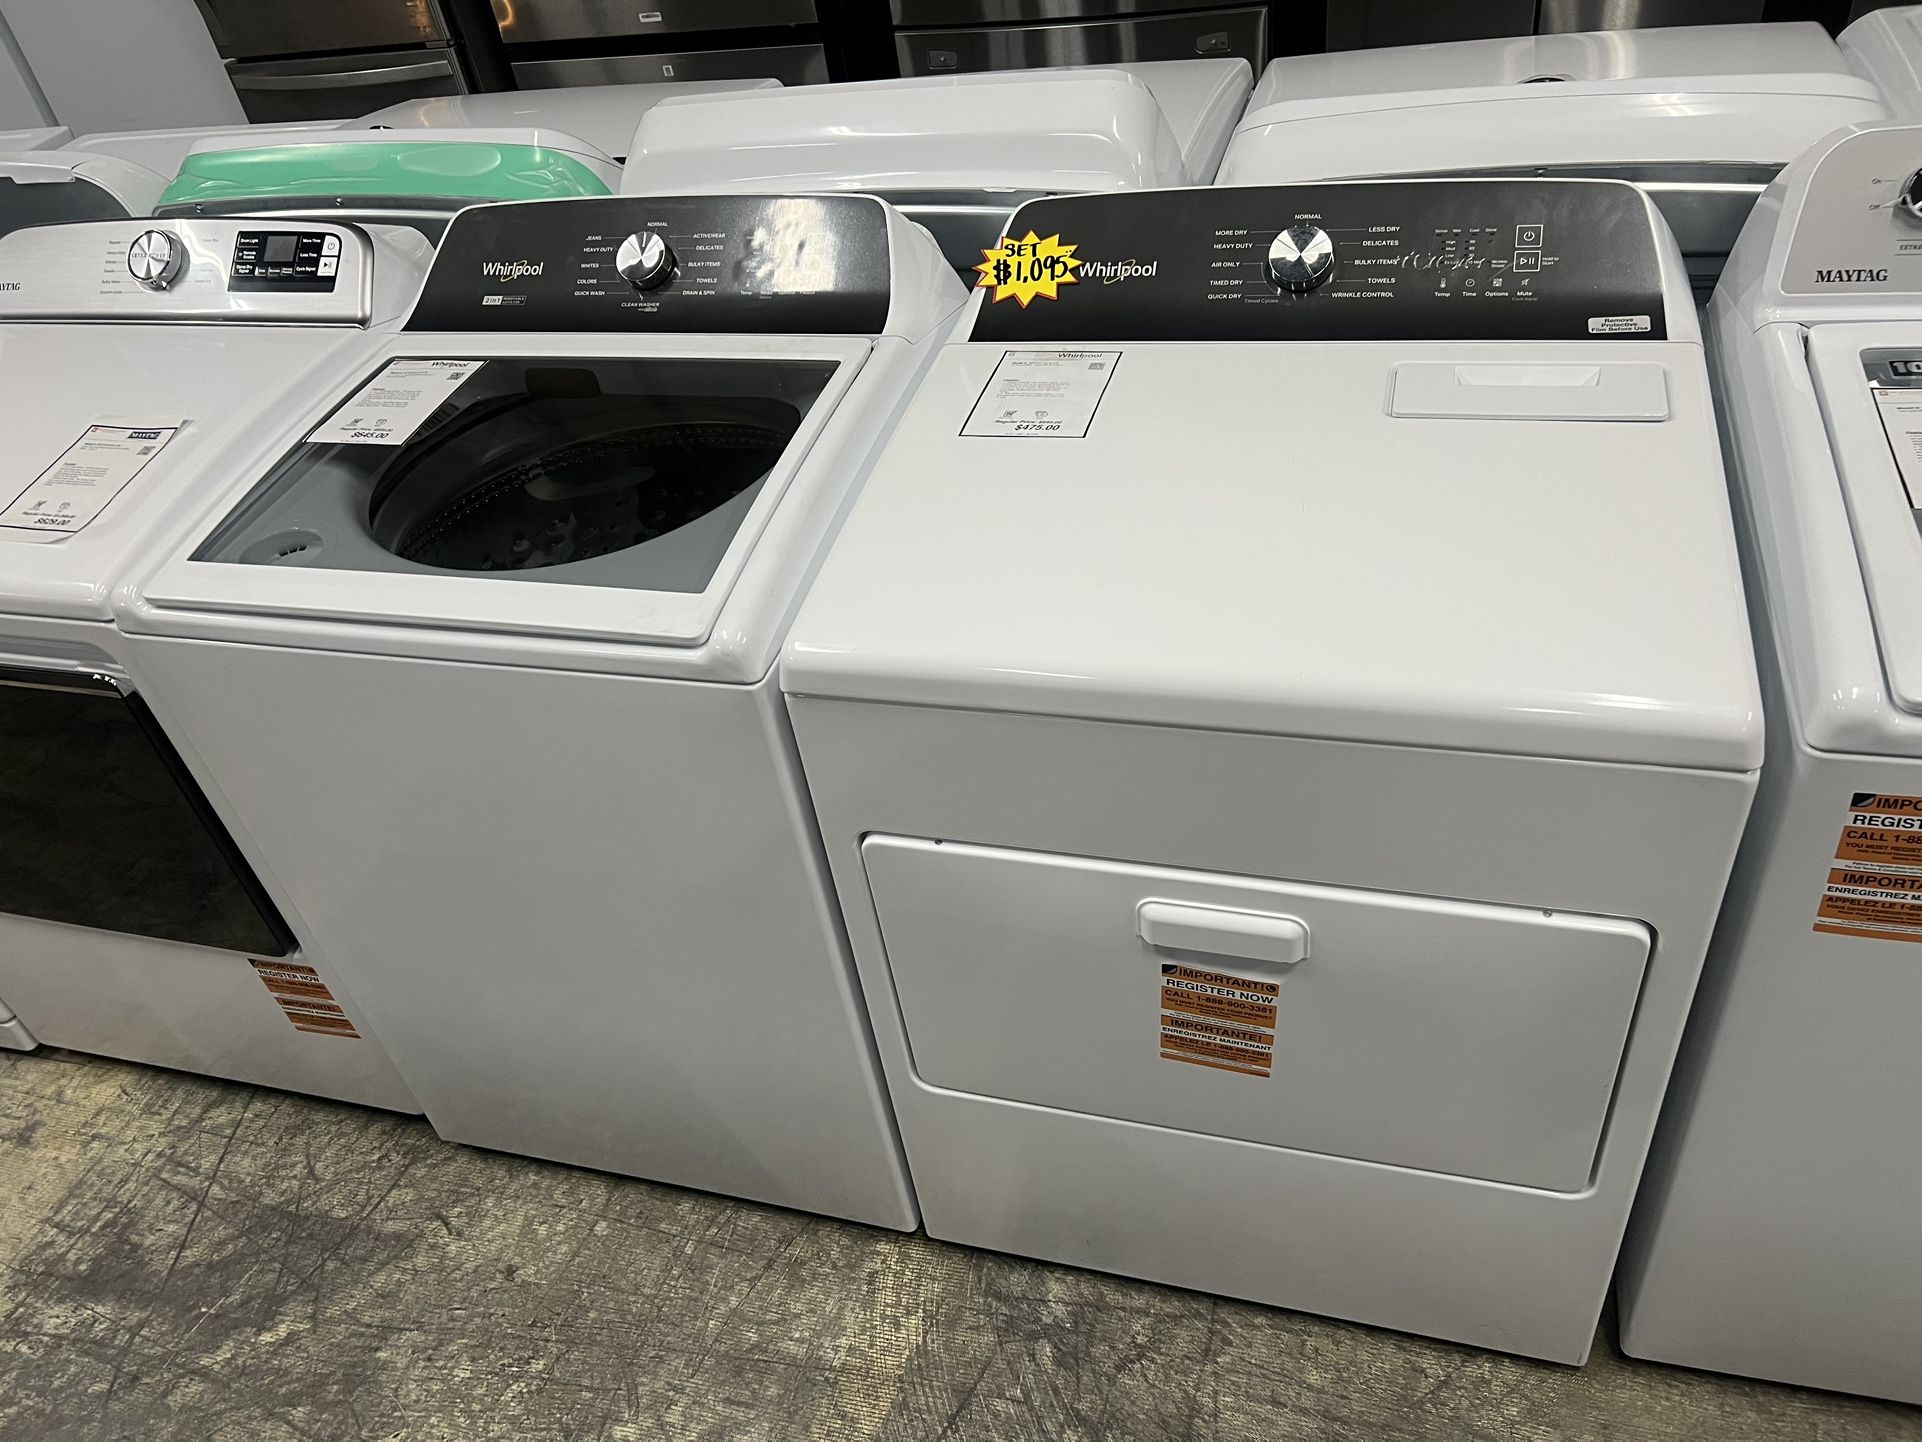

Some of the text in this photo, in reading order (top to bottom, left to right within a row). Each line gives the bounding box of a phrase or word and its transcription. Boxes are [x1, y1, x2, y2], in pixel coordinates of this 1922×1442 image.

[1004, 242, 1041, 257] SET
[483, 262, 544, 279] Whirlpool
[993, 254, 1069, 285] $1,095
[1079, 261, 1157, 281] Whirlpool
[1815, 269, 1888, 283] MAYTAG
[1847, 831, 1888, 841] CALL
[1826, 897, 1879, 907] APPELEZ
[1827, 886, 1908, 900] ENREGISTREZ
[258, 970, 299, 979] REGISTER
[1180, 968, 1264, 993] IMPORTANT!
[1167, 979, 1274, 1004] REGISTER NOW
[1165, 989, 1193, 1000] CALL
[1197, 996, 1272, 1014] 1-888-900-3381
[1162, 1026, 1272, 1051] ENREGISTREZ MAINTENANT
[1170, 1019, 1262, 1042] IMPORTANTE!
